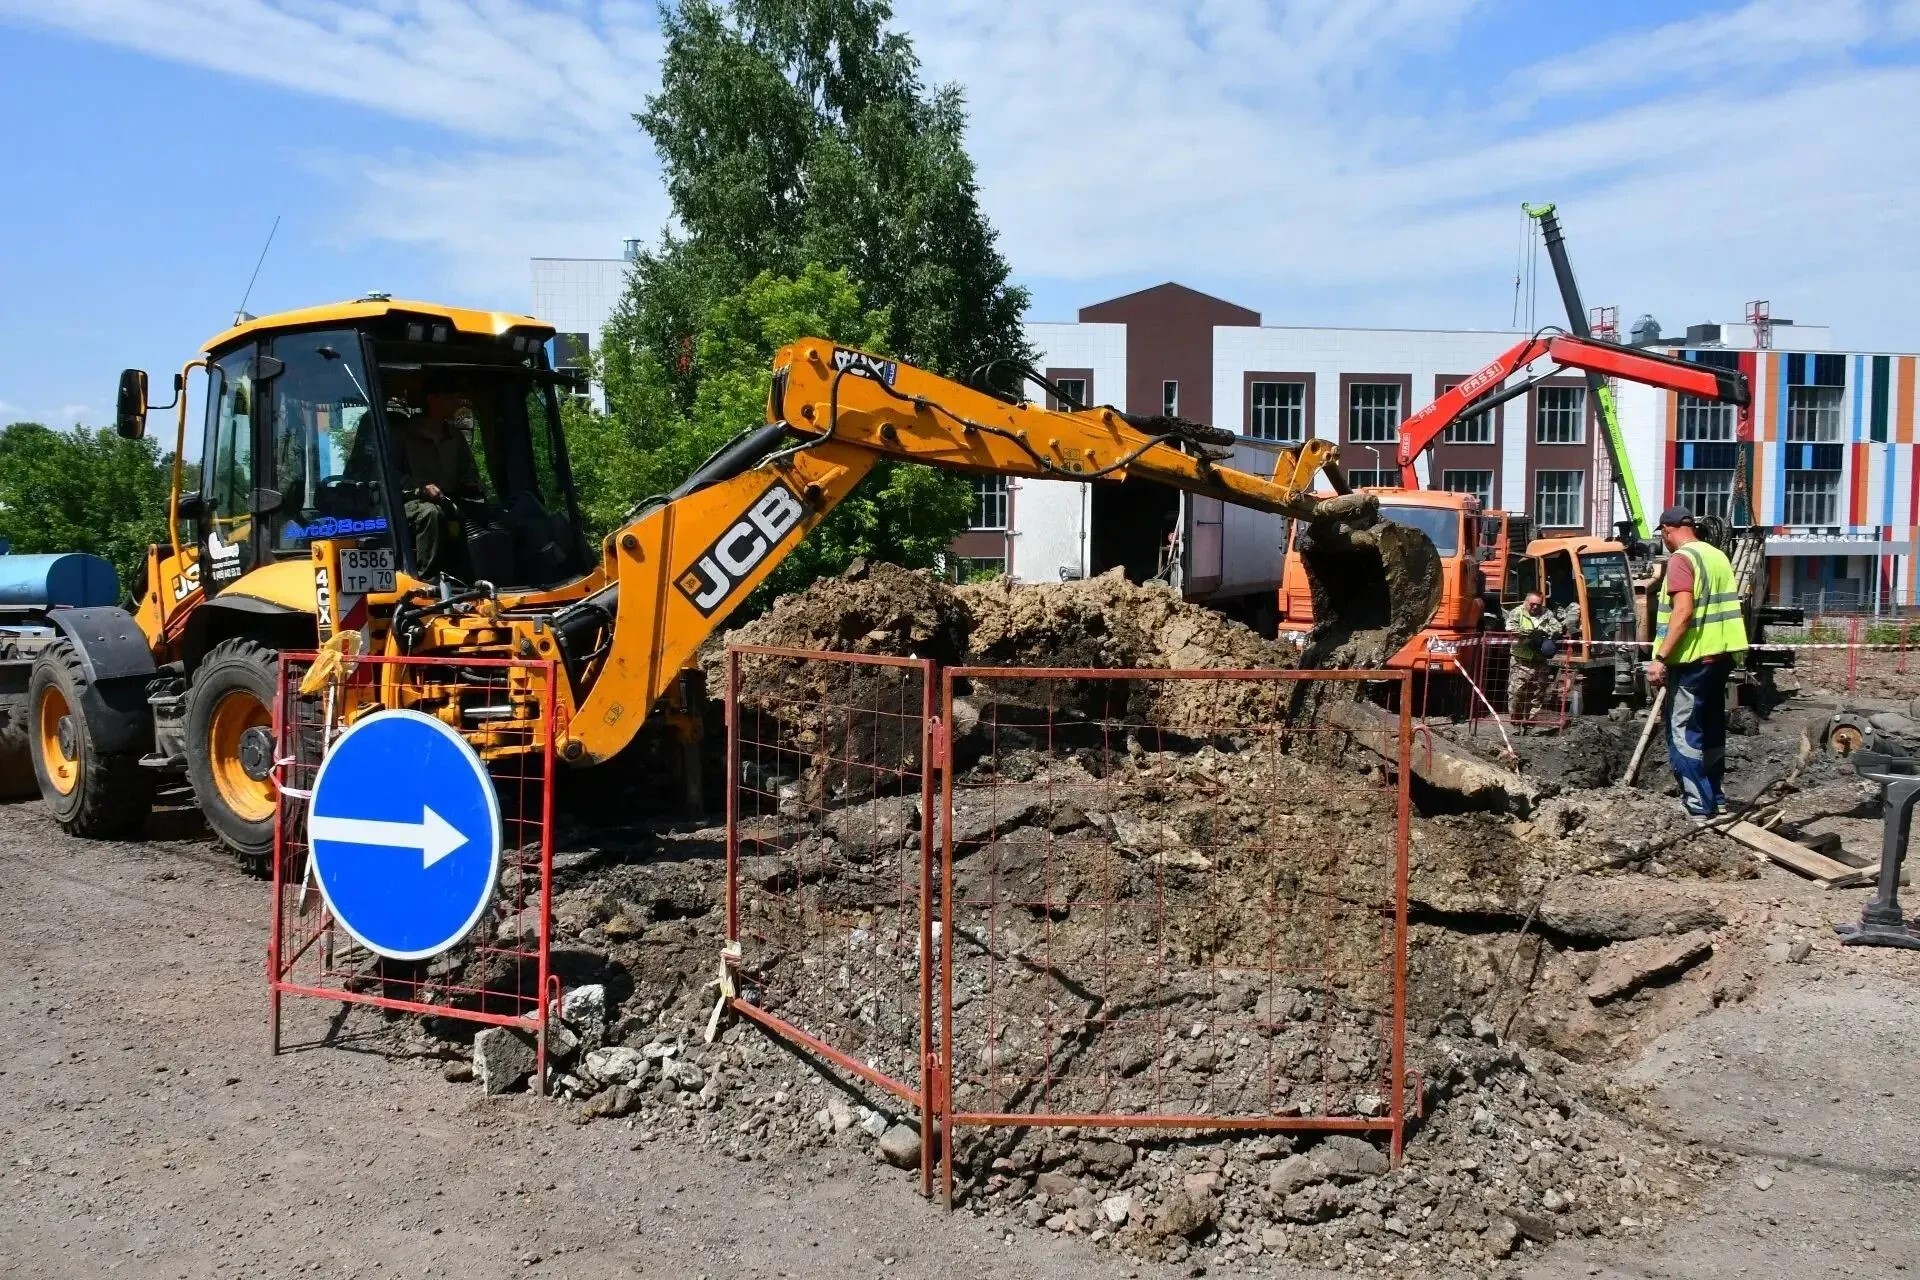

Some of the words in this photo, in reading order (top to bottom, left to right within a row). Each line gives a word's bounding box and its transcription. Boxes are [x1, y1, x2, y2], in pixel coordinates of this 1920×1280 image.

[1463, 364, 1501, 394] FASSI
[349, 551, 388, 568] 8586
[695, 486, 803, 609] JCB
[174, 563, 201, 600] JC
[316, 569, 332, 624] 4CX
[347, 575, 368, 590] TP
[377, 571, 392, 585] 70
